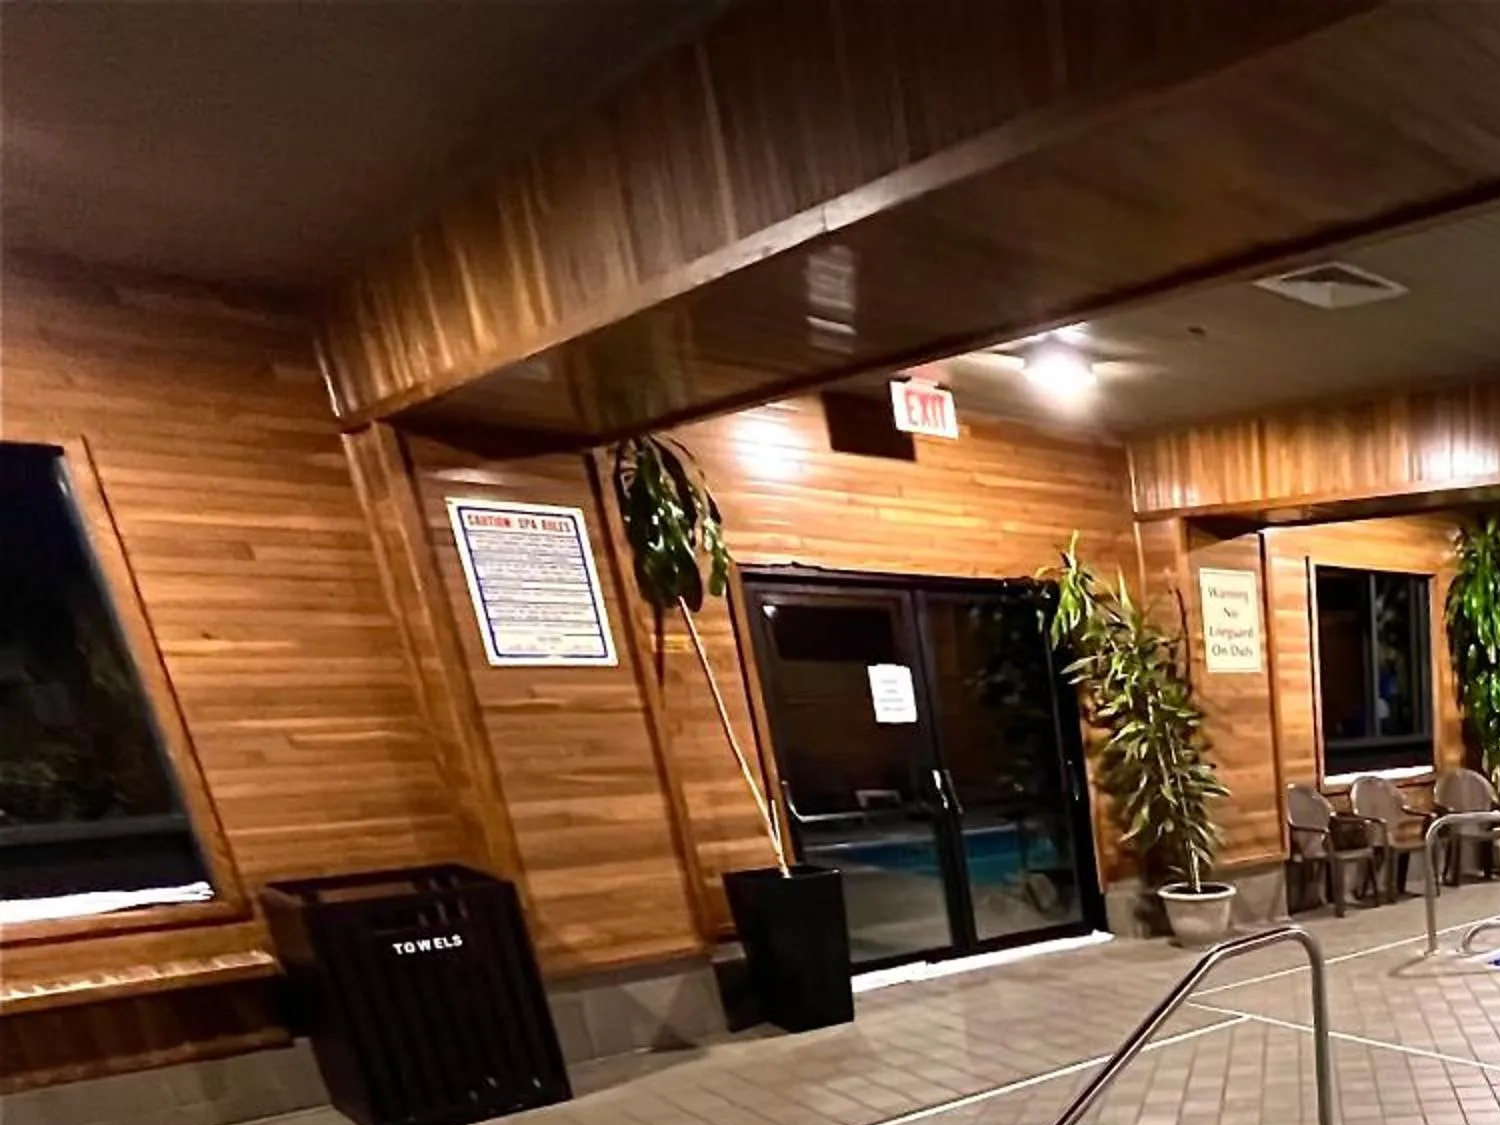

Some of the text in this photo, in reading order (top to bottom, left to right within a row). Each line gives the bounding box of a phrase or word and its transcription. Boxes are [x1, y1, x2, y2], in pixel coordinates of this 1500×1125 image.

[905, 392, 947, 431] EXIT
[467, 514, 571, 532] CAUTION SPA RULES
[1211, 643, 1228, 657] On
[392, 933, 463, 955] TOWELS
